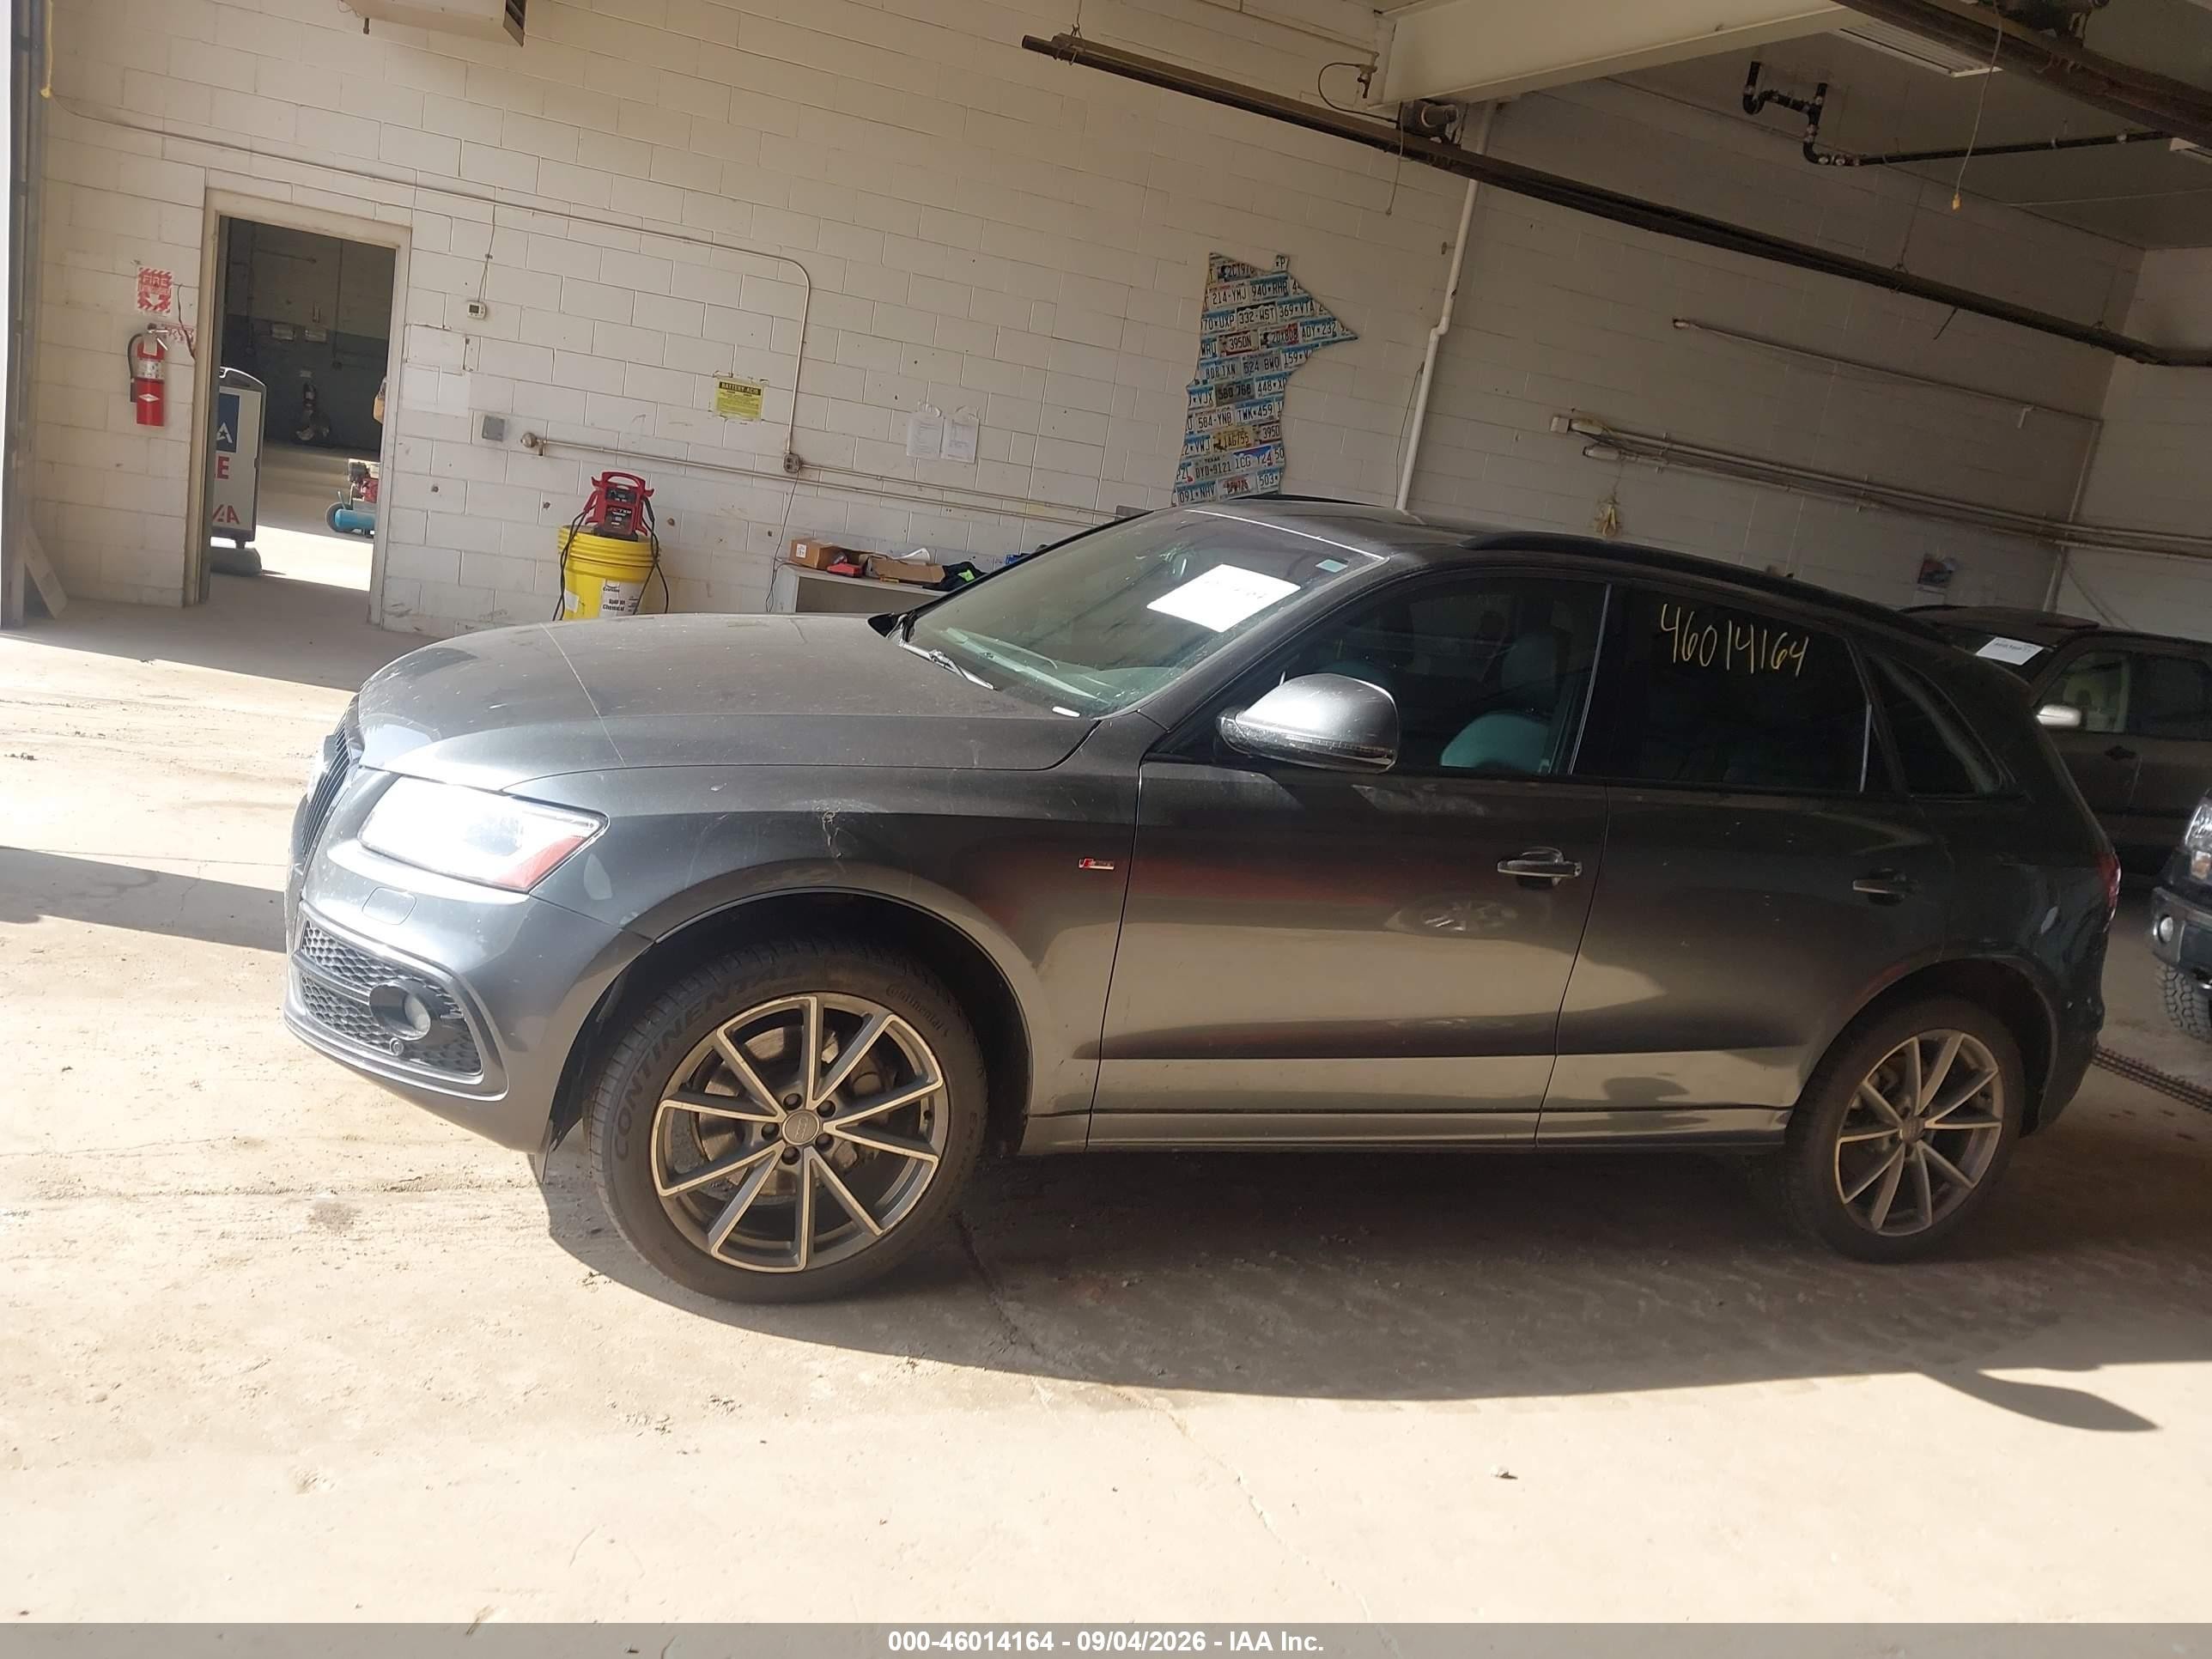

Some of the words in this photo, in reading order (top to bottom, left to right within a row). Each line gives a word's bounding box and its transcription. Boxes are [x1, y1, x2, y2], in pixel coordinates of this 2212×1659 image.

[143, 275, 168, 287] FIRE
[602, 604, 625, 612] Chemical
[1660, 603, 1809, 678] 46014164
